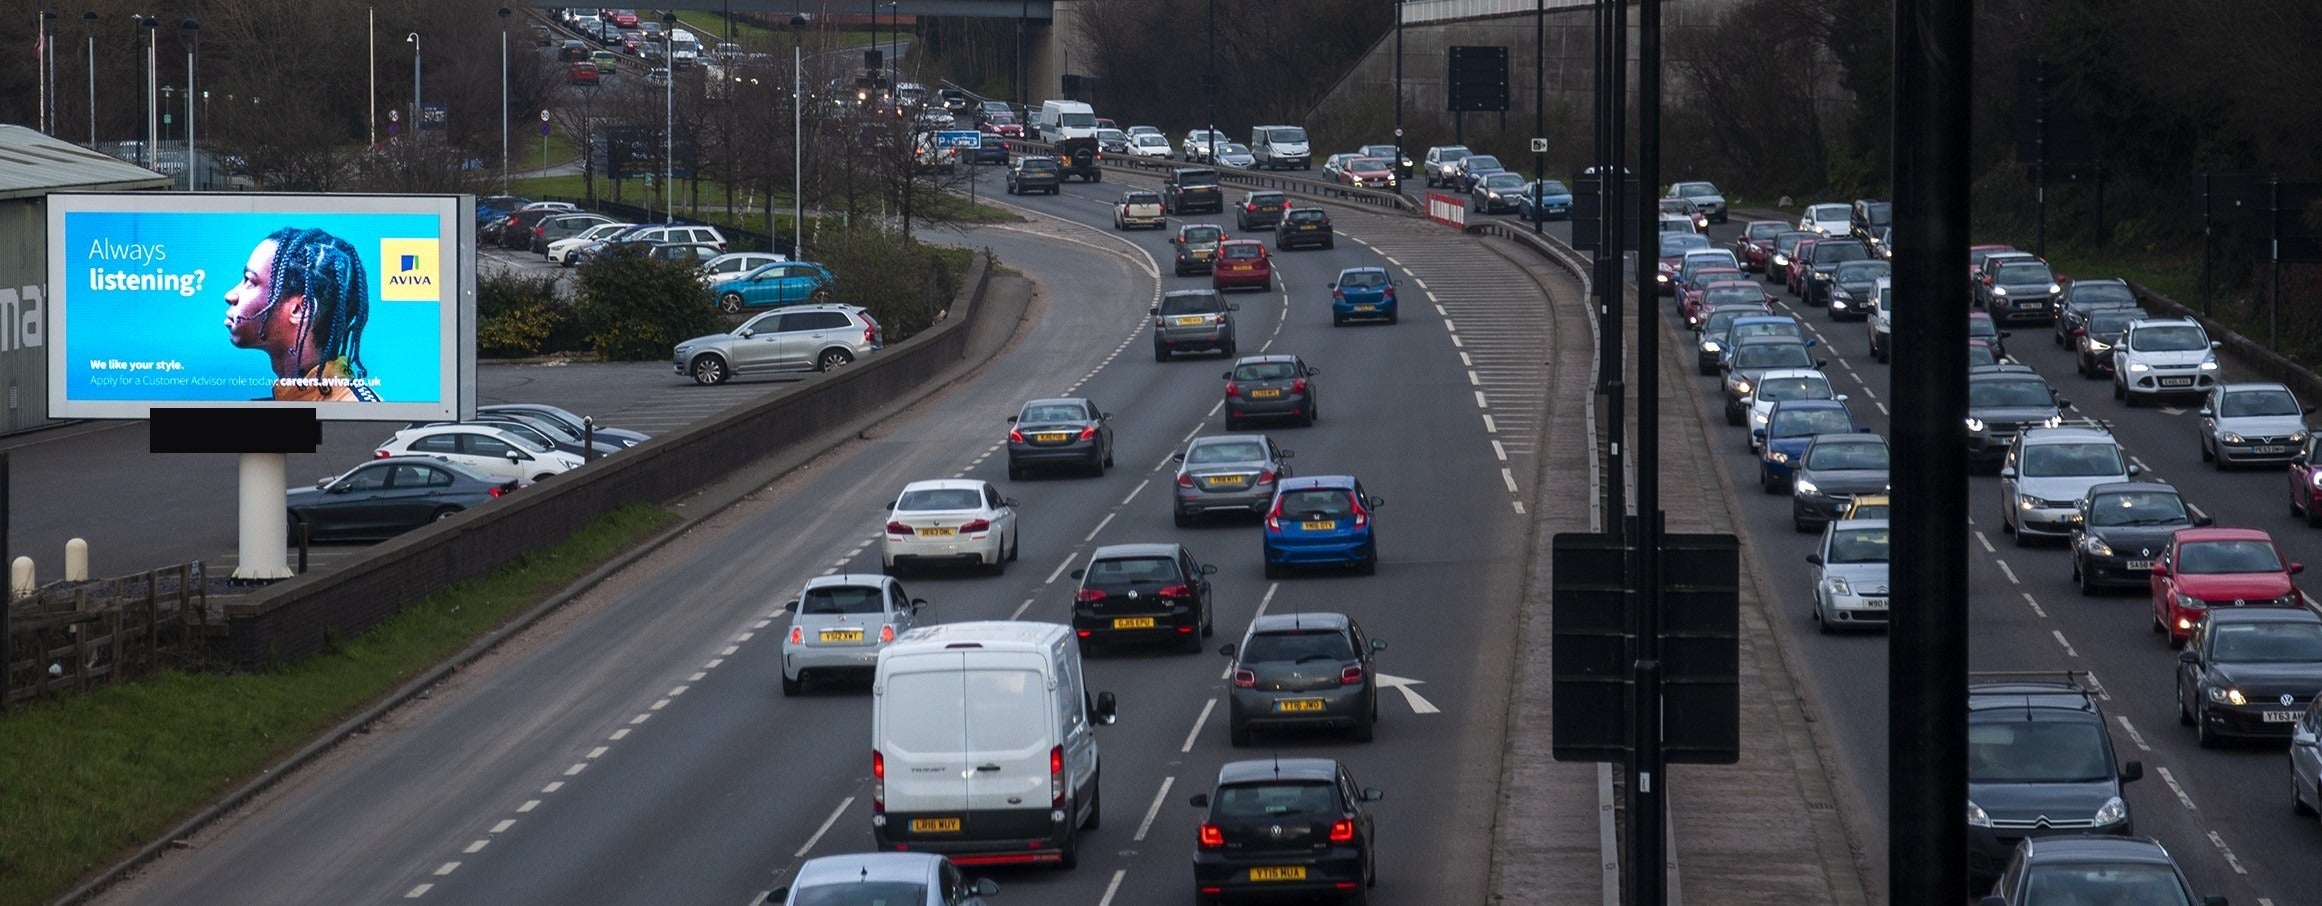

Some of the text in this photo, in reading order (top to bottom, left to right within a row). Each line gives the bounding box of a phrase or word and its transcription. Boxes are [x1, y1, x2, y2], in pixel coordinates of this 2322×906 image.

[88, 237, 167, 267] Always
[89, 267, 207, 297] listening?
[389, 275, 432, 286] AVIVA
[90, 359, 185, 372] We like your style.
[90, 375, 118, 388] Apply
[119, 375, 132, 386] for
[134, 378, 141, 386] a
[142, 375, 189, 387] Customer
[191, 375, 227, 386] Advisor
[228, 375, 247, 386] role
[280, 376, 381, 387] careers.aviva.co.uk
[2267, 711, 2290, 721] YT63
